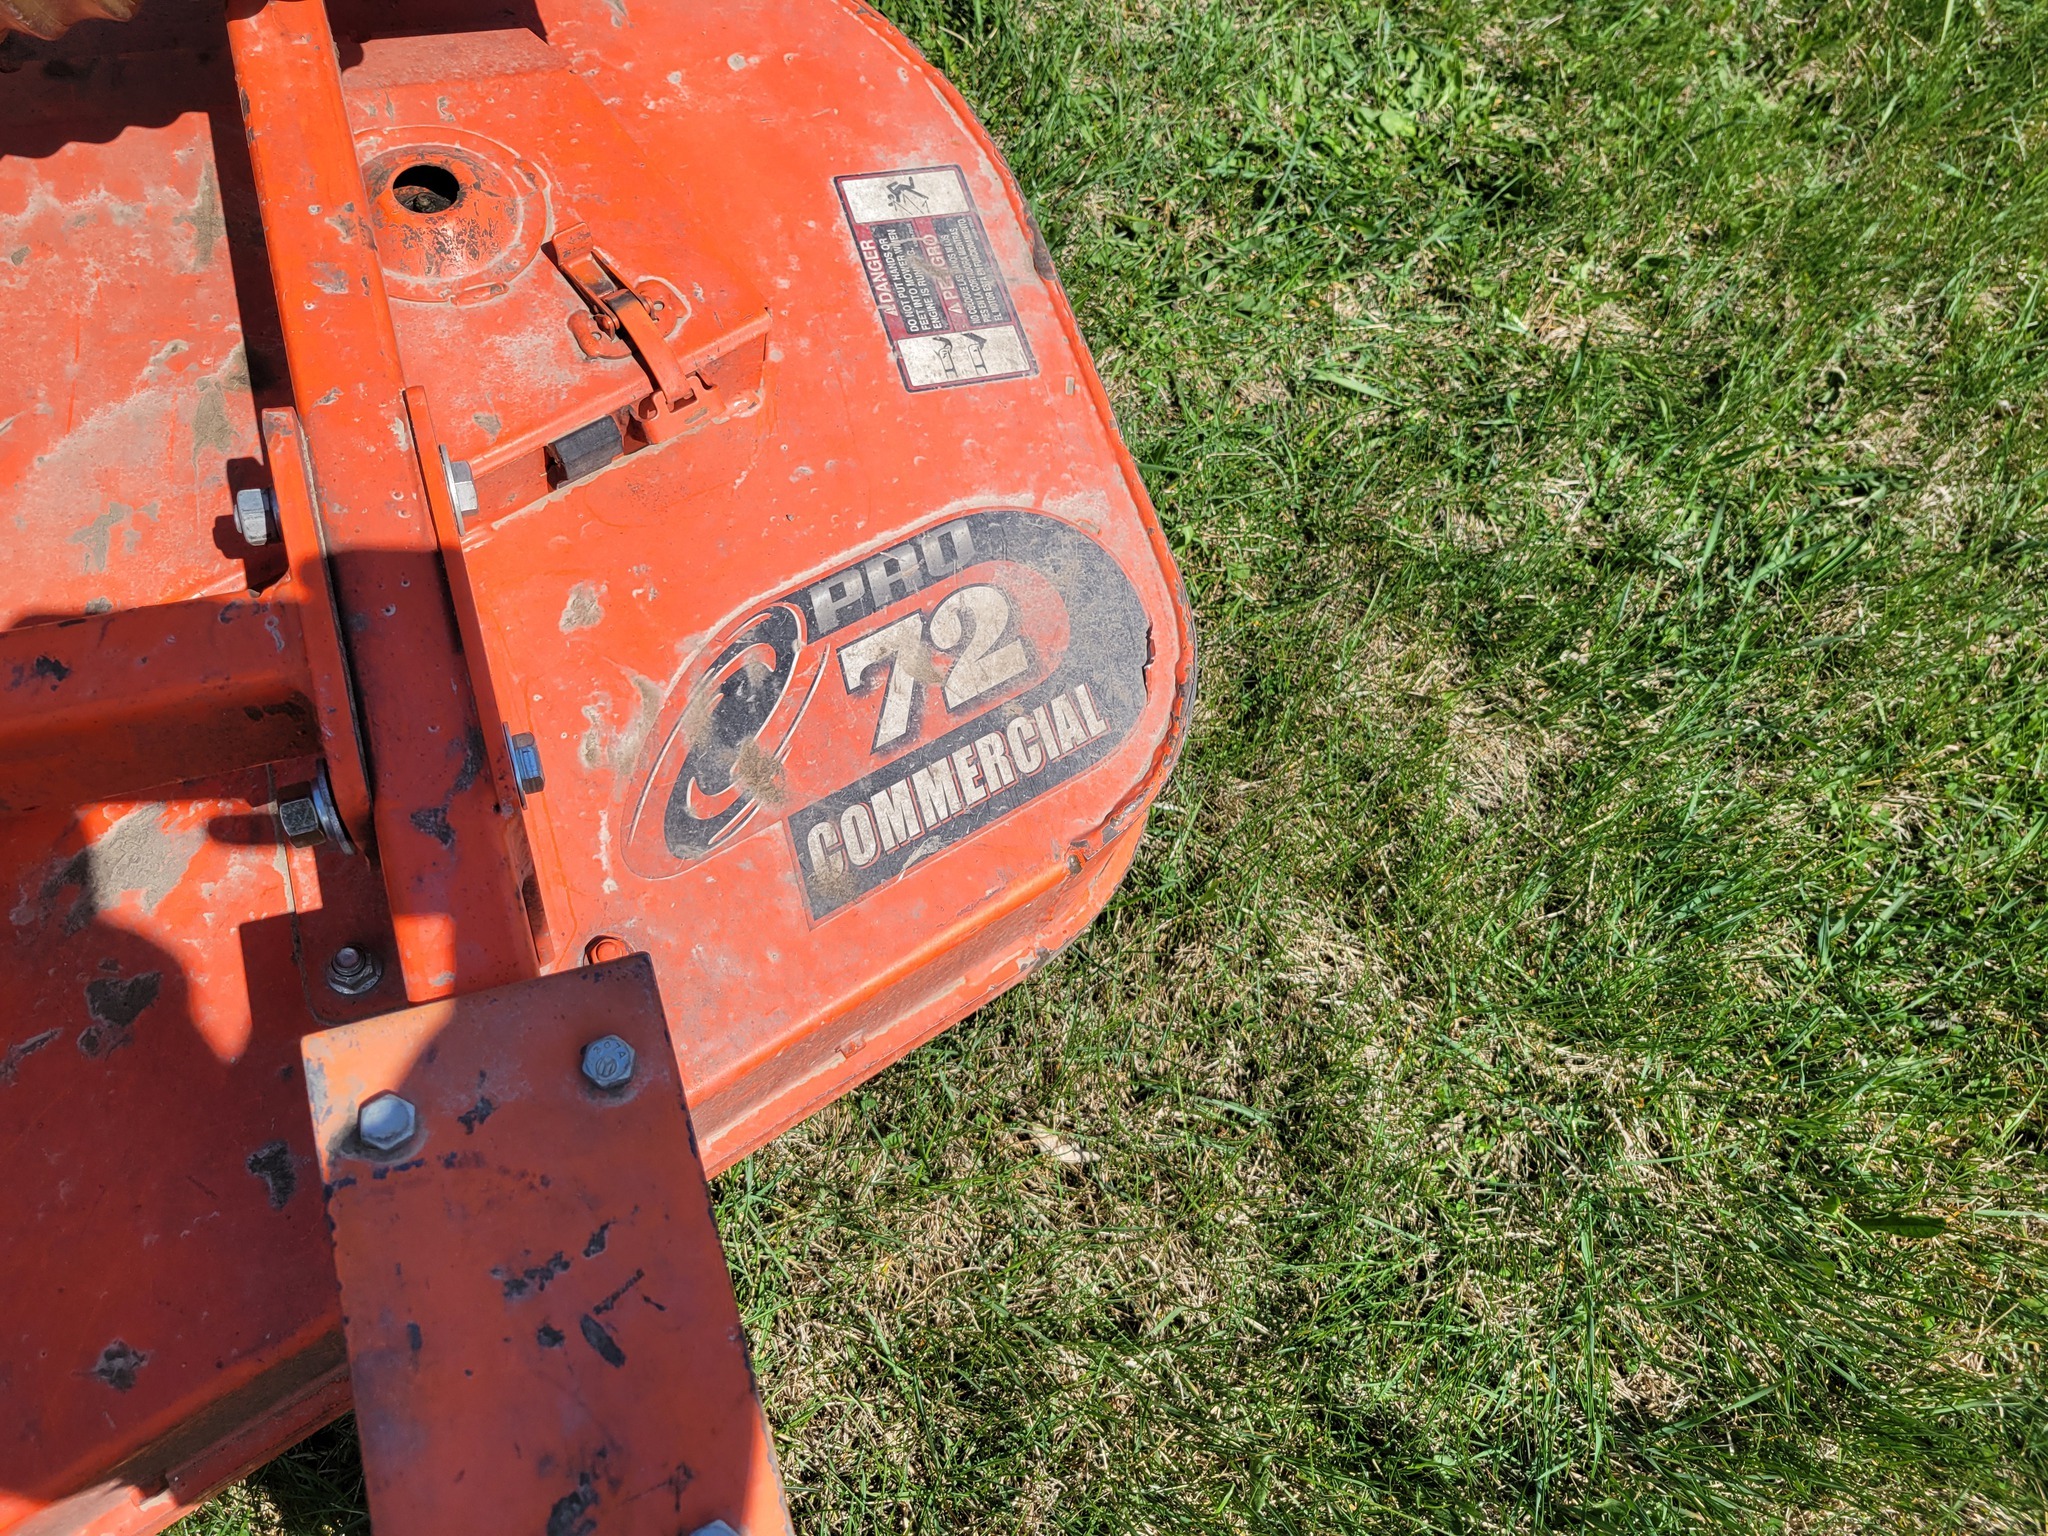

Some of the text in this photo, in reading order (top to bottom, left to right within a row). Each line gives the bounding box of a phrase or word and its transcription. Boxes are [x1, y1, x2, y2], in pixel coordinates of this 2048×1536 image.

[886, 228, 904, 254] WEN
[859, 239, 894, 303] DANGER
[896, 255, 916, 286] MOWER
[905, 247, 927, 286] RUNG.
[921, 233, 958, 300] PEGRO
[947, 253, 962, 274] ANOS
[975, 267, 986, 275] EN
[878, 237, 919, 332] DO NOT PUT HANDS OR
[954, 274, 967, 285] LAS
[907, 287, 923, 307] INTO
[919, 287, 931, 295] IS
[972, 291, 984, 299] LA
[984, 291, 1000, 312] MOTOR
[922, 296, 942, 329] ENGINE
[975, 299, 987, 308] EN
[915, 309, 931, 330] FEET
[969, 314, 981, 324] NO
[979, 309, 992, 322] PIES
[992, 313, 1003, 321] EL
[810, 517, 978, 634] PRO
[838, 583, 1030, 753] 72
[806, 683, 1109, 876] COMMERCIAL
